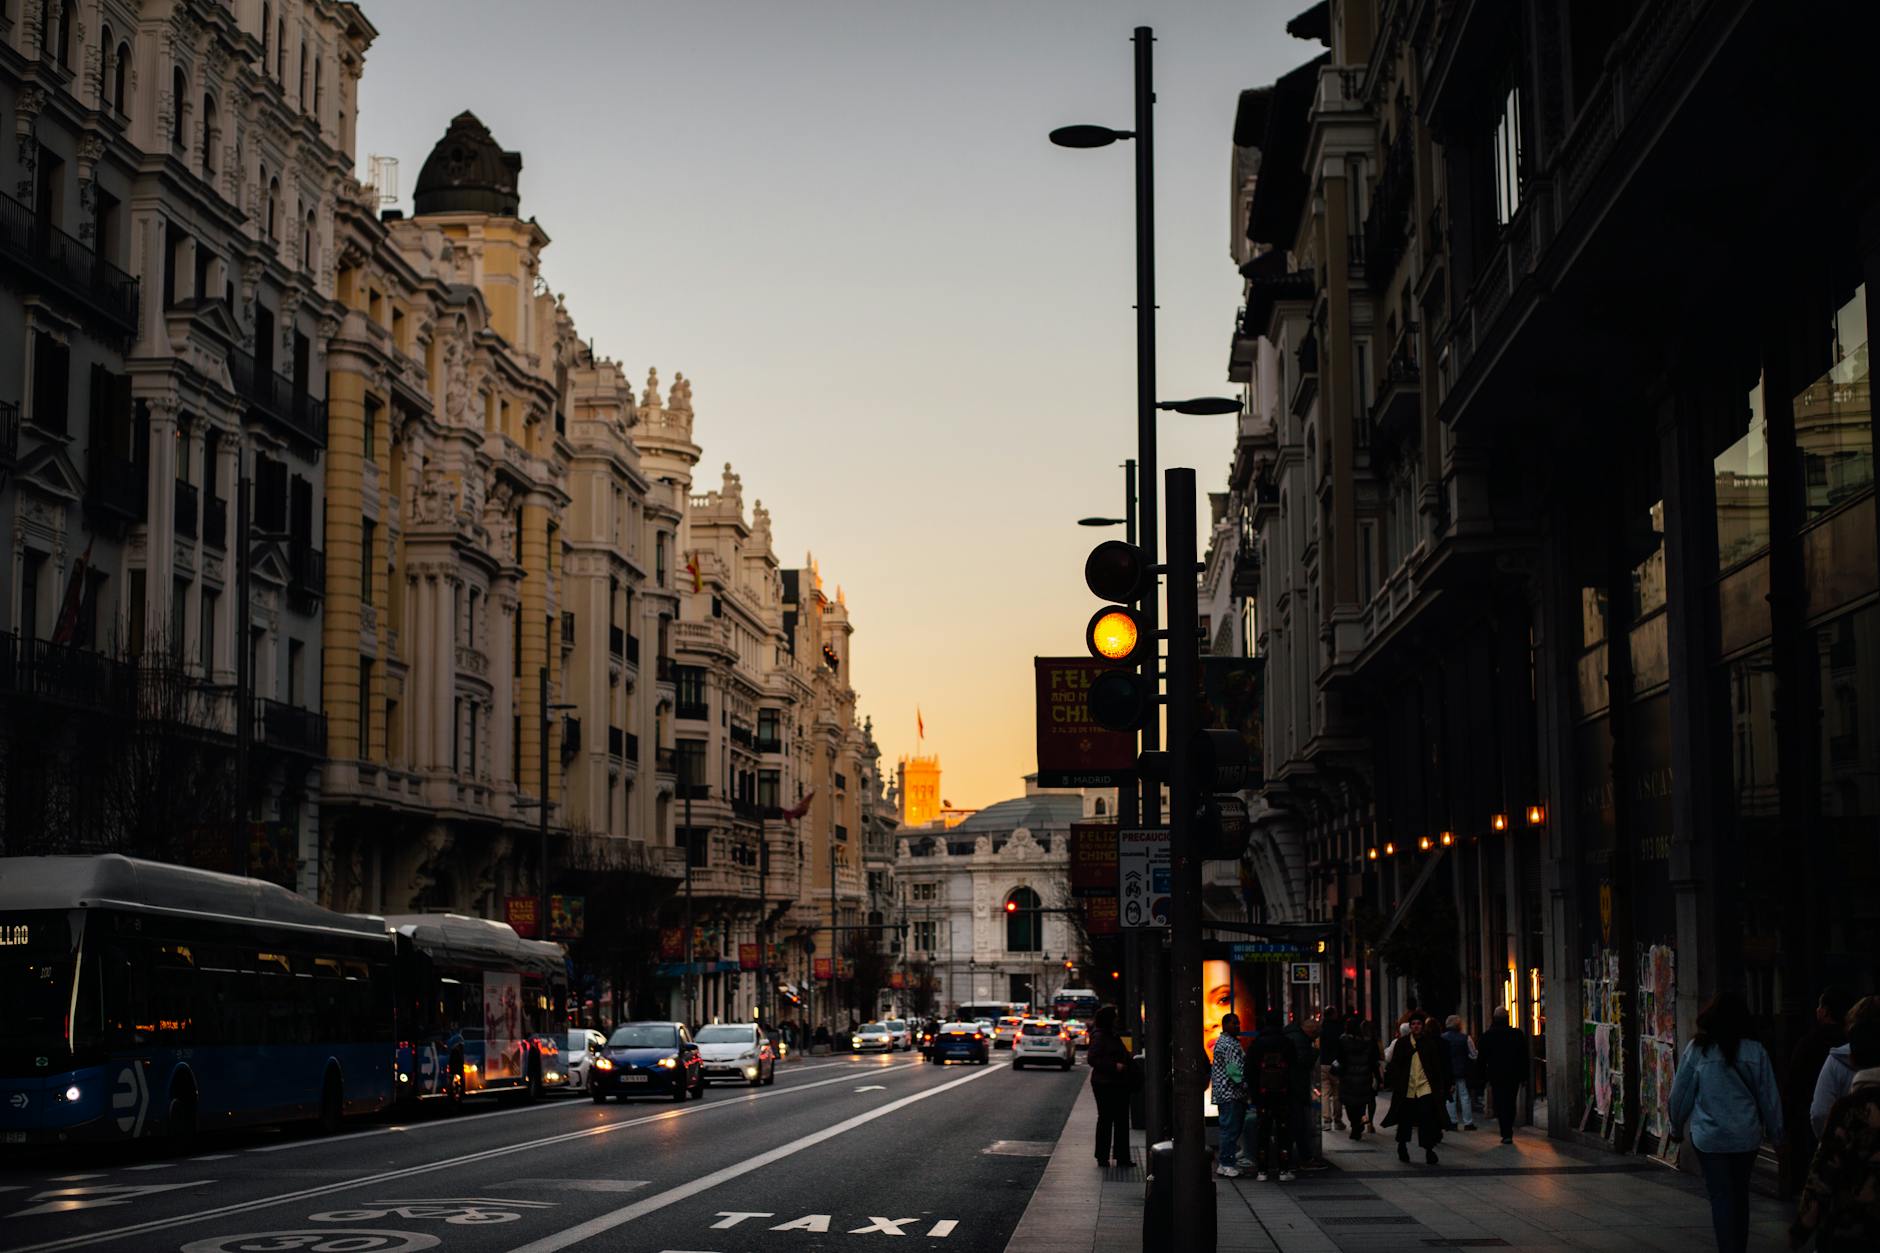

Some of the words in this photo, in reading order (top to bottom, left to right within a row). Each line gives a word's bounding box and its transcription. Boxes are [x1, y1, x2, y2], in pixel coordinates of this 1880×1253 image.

[1051, 669, 1103, 689] FEL
[1052, 704, 1094, 723] CHI
[1073, 776, 1112, 784] MADRID
[709, 1211, 960, 1238] TAXI
[240, 1235, 388, 1252] 30
